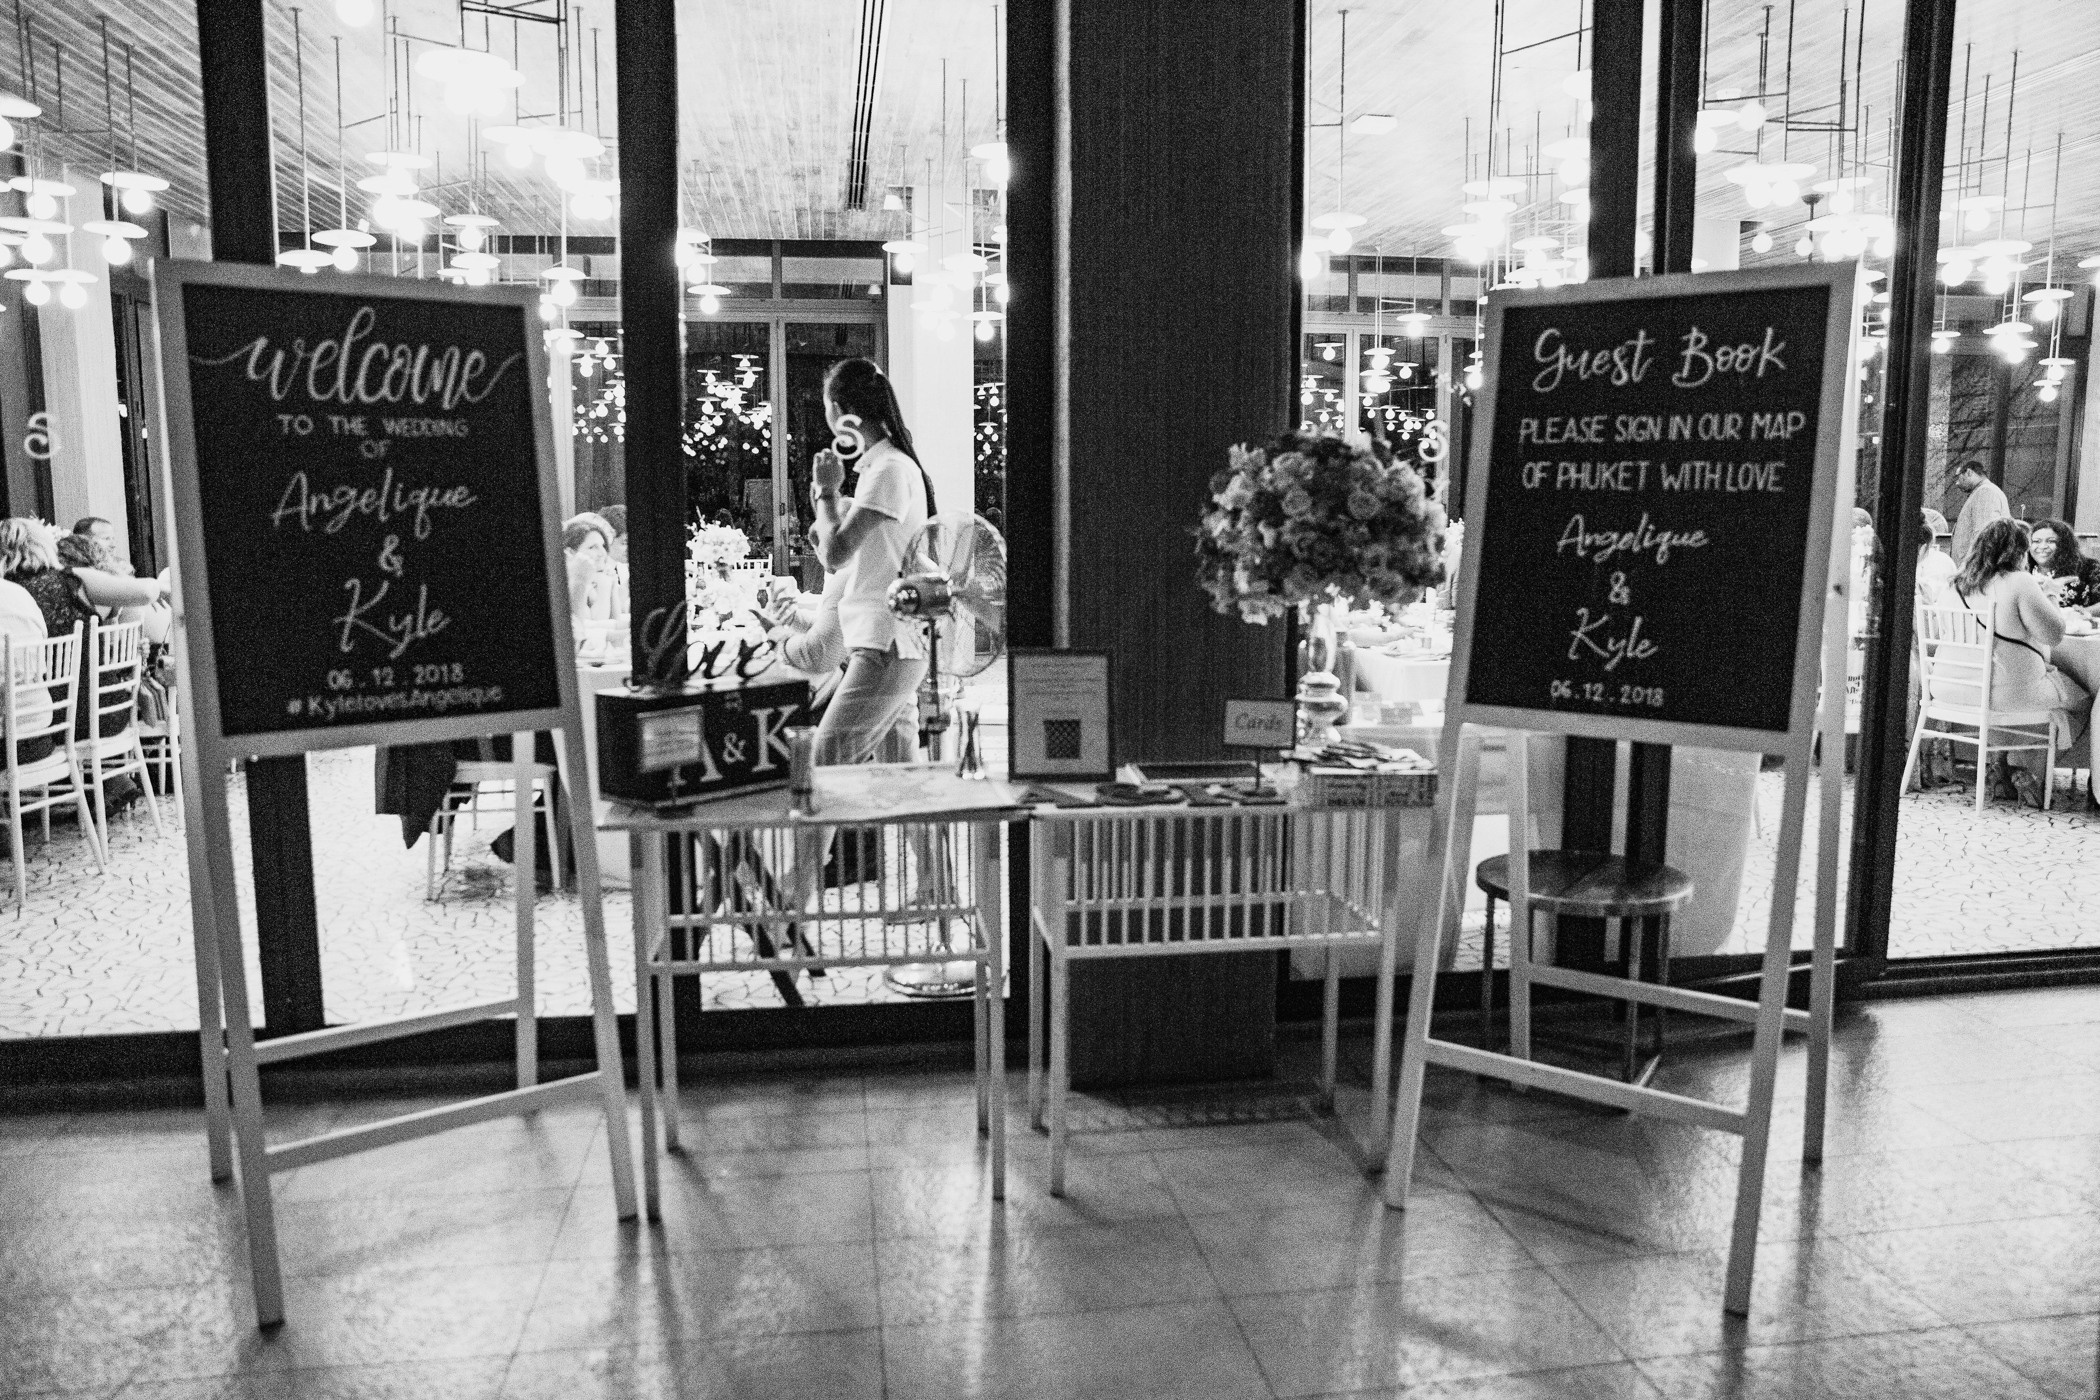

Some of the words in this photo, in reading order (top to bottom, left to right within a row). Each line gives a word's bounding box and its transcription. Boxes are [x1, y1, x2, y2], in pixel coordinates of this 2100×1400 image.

[1532, 328, 1655, 393] Guest
[1672, 326, 1787, 388] Book
[277, 414, 314, 435] TO
[328, 415, 368, 436] THE
[382, 418, 470, 438] WEDDING
[360, 439, 392, 459] OF
[1518, 414, 1608, 445] PLEASE
[1614, 412, 1662, 443] SIGN
[1668, 412, 1693, 441] IN
[1698, 412, 1743, 441] OUR
[1750, 410, 1806, 440] MAP
[1521, 460, 1552, 490] OF
[1556, 459, 1651, 491] PHUKET
[1660, 459, 1722, 492] WITH
[1725, 460, 1787, 493] LOVE
[270, 466, 478, 540] Angelique
[378, 534, 404, 577] &
[1557, 511, 1710, 565] Angelique
[1608, 570, 1631, 606] &
[332, 577, 452, 660] Kyle
[1568, 607, 1660, 672] Kyle
[723, 732, 746, 765] &
[750, 704, 799, 773] K
